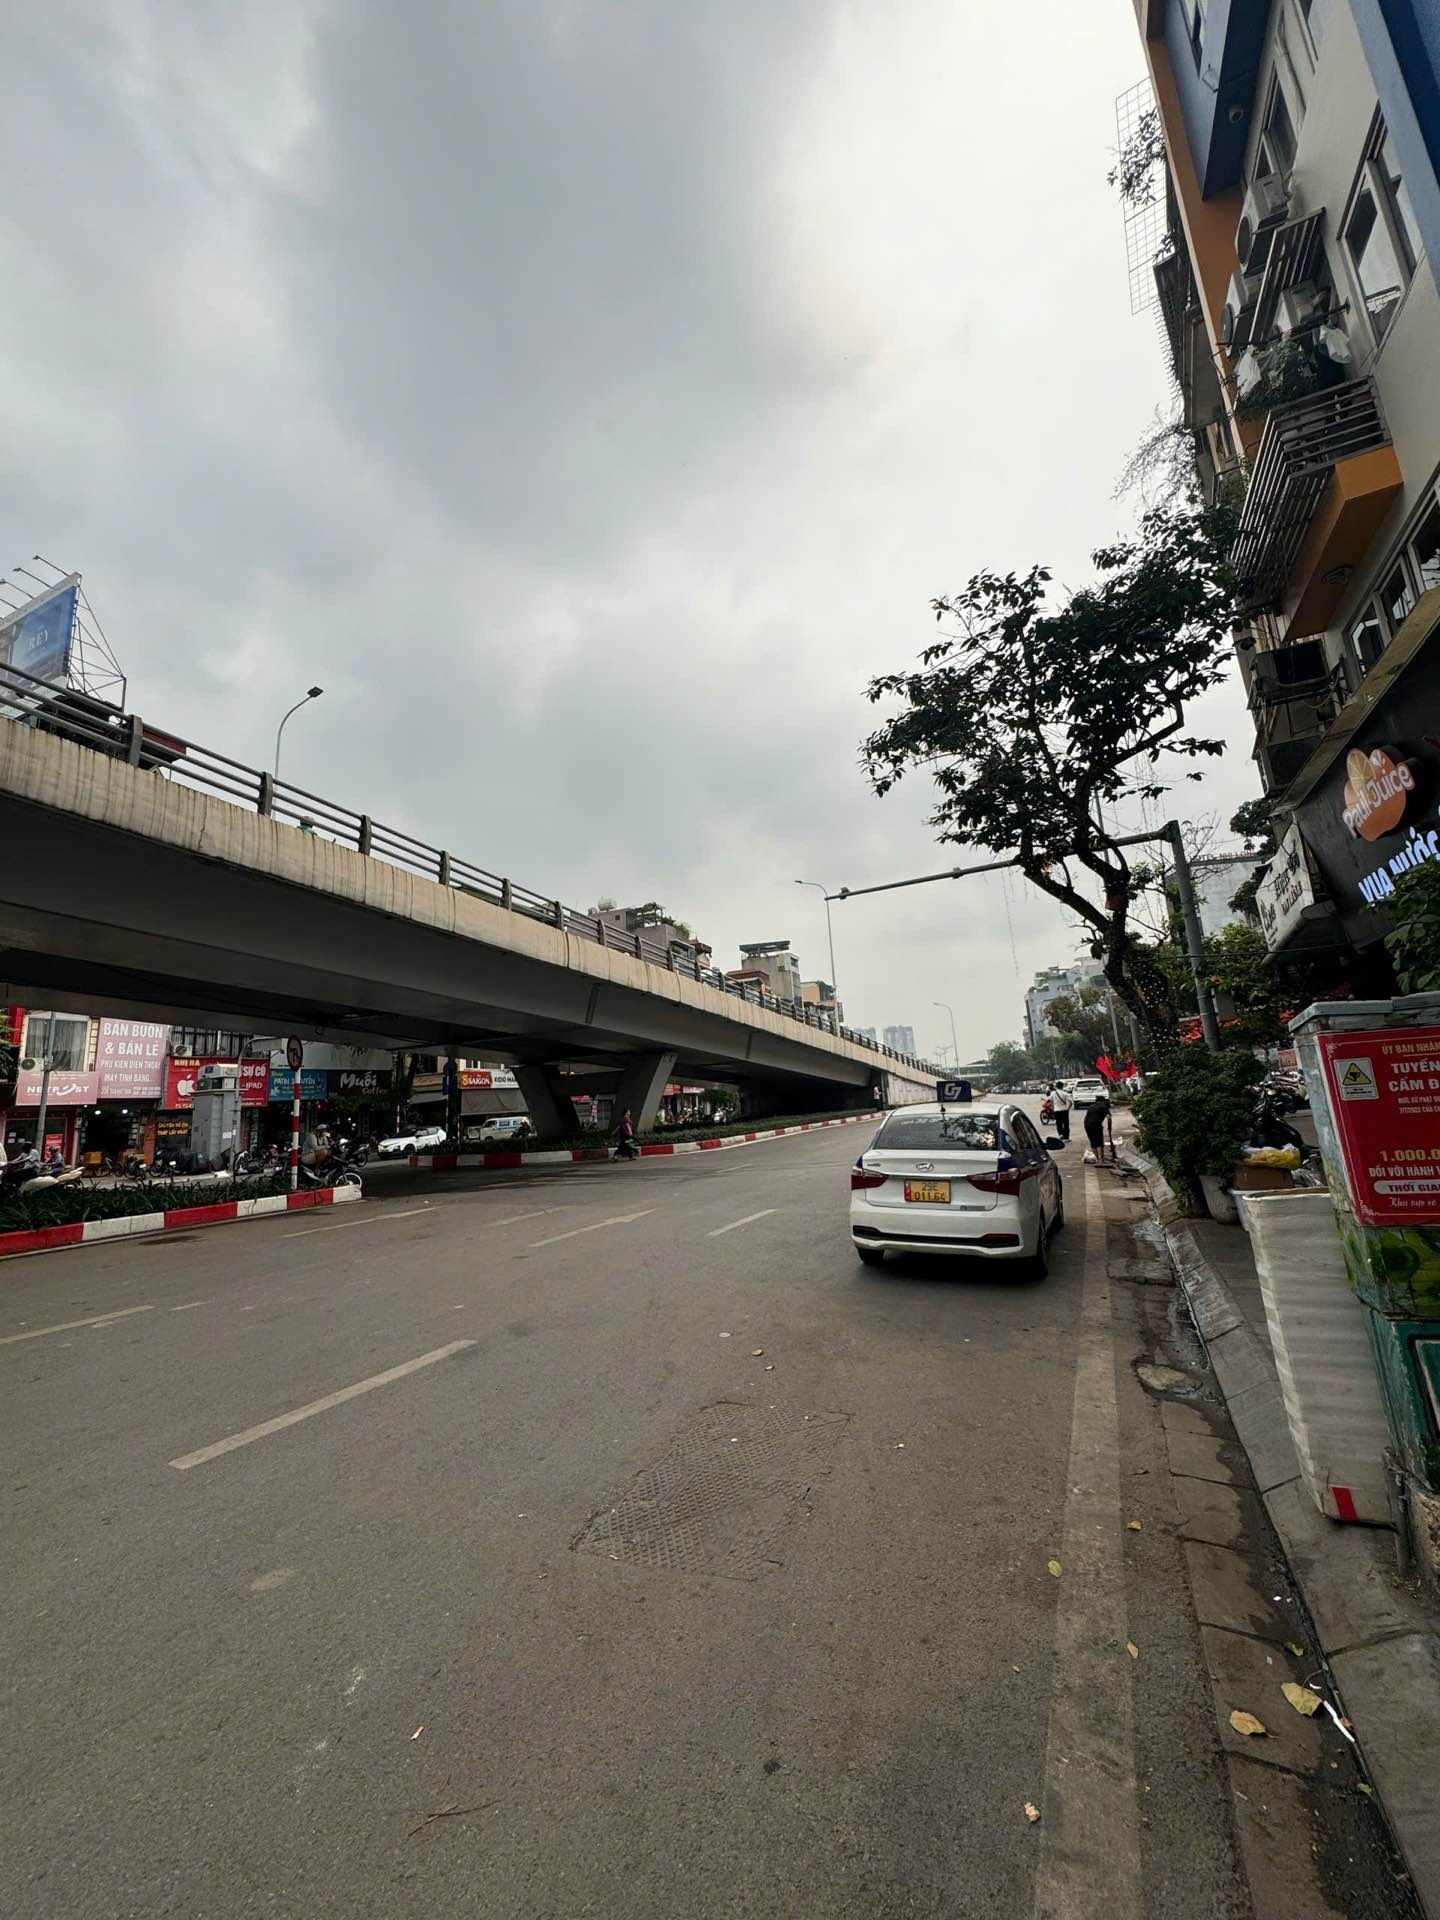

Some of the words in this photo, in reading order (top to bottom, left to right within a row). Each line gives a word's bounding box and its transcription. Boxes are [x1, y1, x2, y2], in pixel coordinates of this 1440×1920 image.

[1367, 762, 1415, 807] Juice
[105, 1041, 114, 1054] &
[118, 1040, 143, 1055] BÁN
[944, 1083, 962, 1099] G7
[914, 1191, 946, 1200] 011.64
